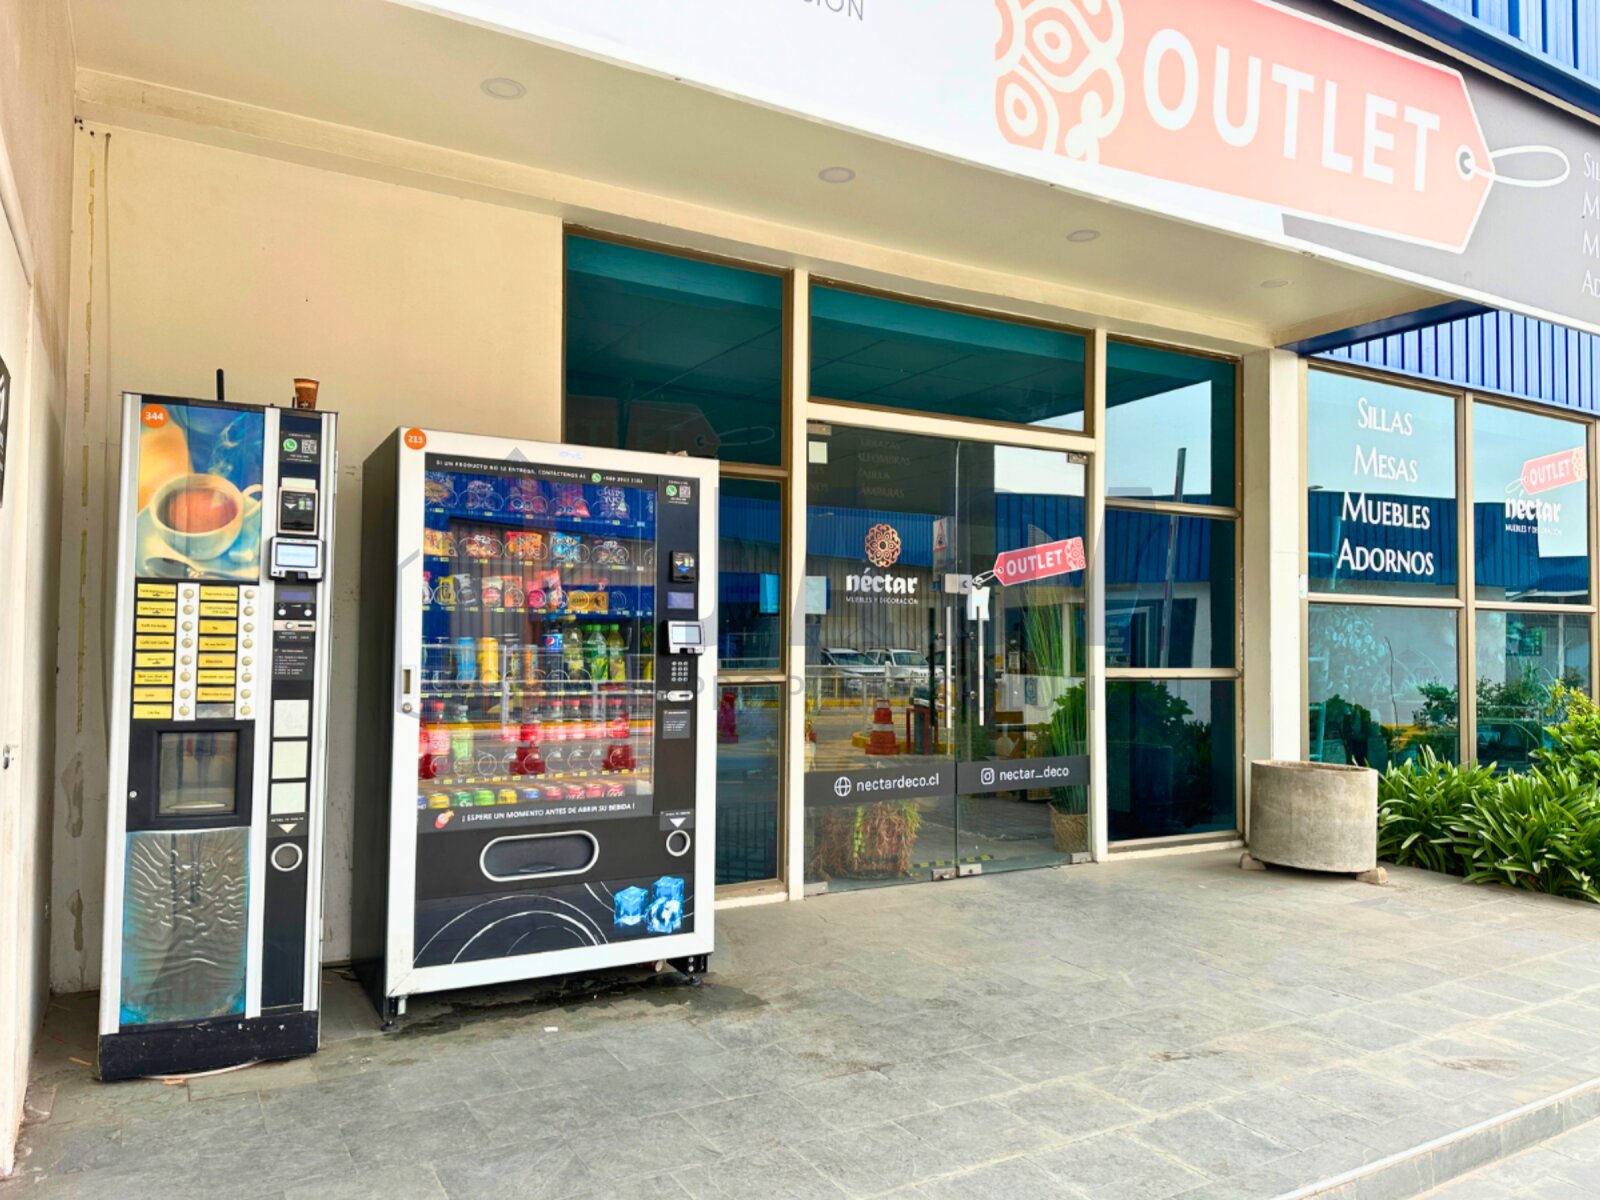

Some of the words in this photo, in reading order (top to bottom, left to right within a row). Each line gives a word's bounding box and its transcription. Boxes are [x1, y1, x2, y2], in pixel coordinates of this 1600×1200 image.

[1143, 27, 1441, 193] OUTLET
[144, 411, 164, 422] 344
[1357, 396, 1413, 437] SILLAS
[407, 434, 424, 445] 213
[1354, 444, 1418, 483] MESAS
[1529, 459, 1573, 487] OUTLET
[1341, 491, 1430, 530] MUEBLES
[1505, 490, 1562, 523] néctar
[1006, 548, 1063, 577] OUTLET
[1337, 538, 1435, 576] ADORNOS
[846, 567, 918, 594] néctar
[856, 773, 940, 793] nectardeco.cl
[998, 766, 1070, 782] nectar_deco
[467, 811, 492, 822] ESPERE
[494, 811, 504, 819] UN
[506, 809, 544, 818] MOMENTO
[545, 808, 567, 816] ANTES
[578, 805, 598, 813] ABRIR
[609, 803, 631, 811] BEBIDA
